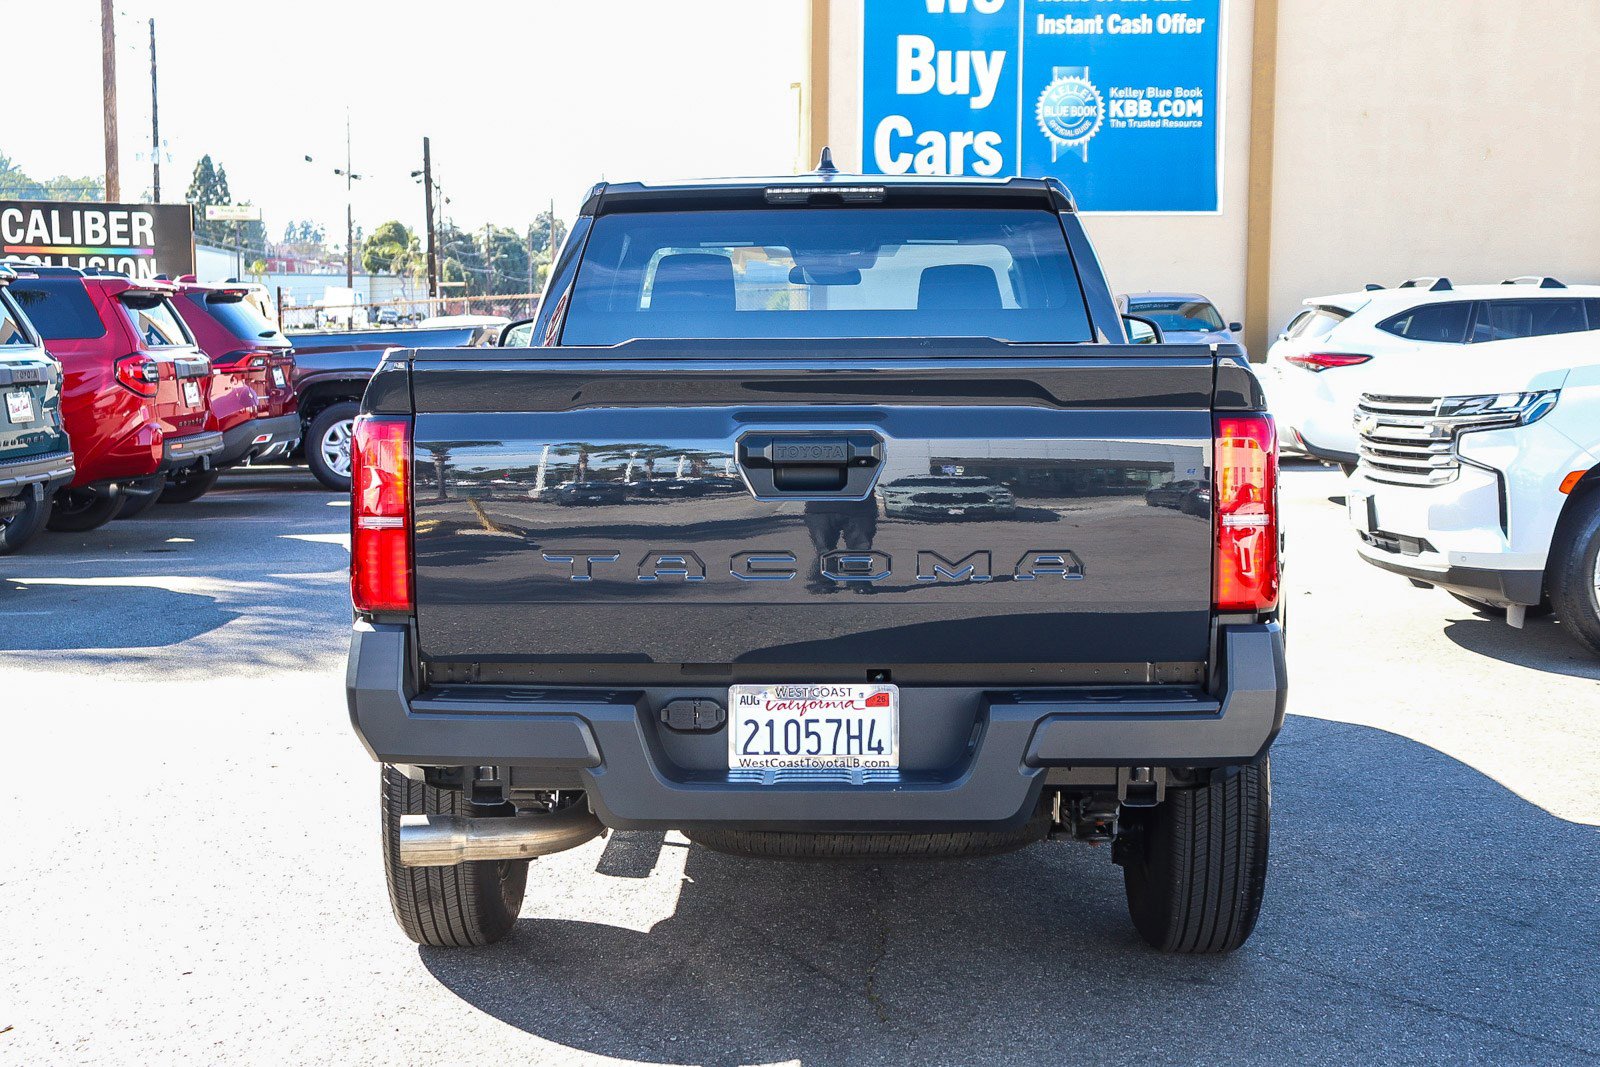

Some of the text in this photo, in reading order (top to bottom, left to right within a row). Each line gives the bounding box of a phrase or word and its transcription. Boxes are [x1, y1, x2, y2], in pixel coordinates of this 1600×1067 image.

[1037, 12, 1206, 35] Instant Cash Offer
[896, 34, 1007, 110] Buy
[1050, 84, 1095, 102] KELLEY
[1109, 86, 1203, 100] Kelley Blue Book
[1044, 105, 1098, 118] BLUE BOOK
[1109, 99, 1203, 118] KBB.COM
[1049, 119, 1092, 137] OFFICIAL GUIDE
[1110, 119, 1203, 128] The Trusted Resource
[873, 114, 1004, 177] Cars
[1, 207, 156, 246] CALIBER
[777, 445, 844, 458] TOYOTA
[541, 548, 1085, 582] TACOMA
[739, 694, 760, 706] AUG
[774, 687, 853, 698] WEST COAST
[876, 695, 886, 703] 26
[765, 700, 865, 717] California
[742, 718, 885, 755] 21057H4
[739, 758, 890, 769] WestCoastToyotaLB.com
